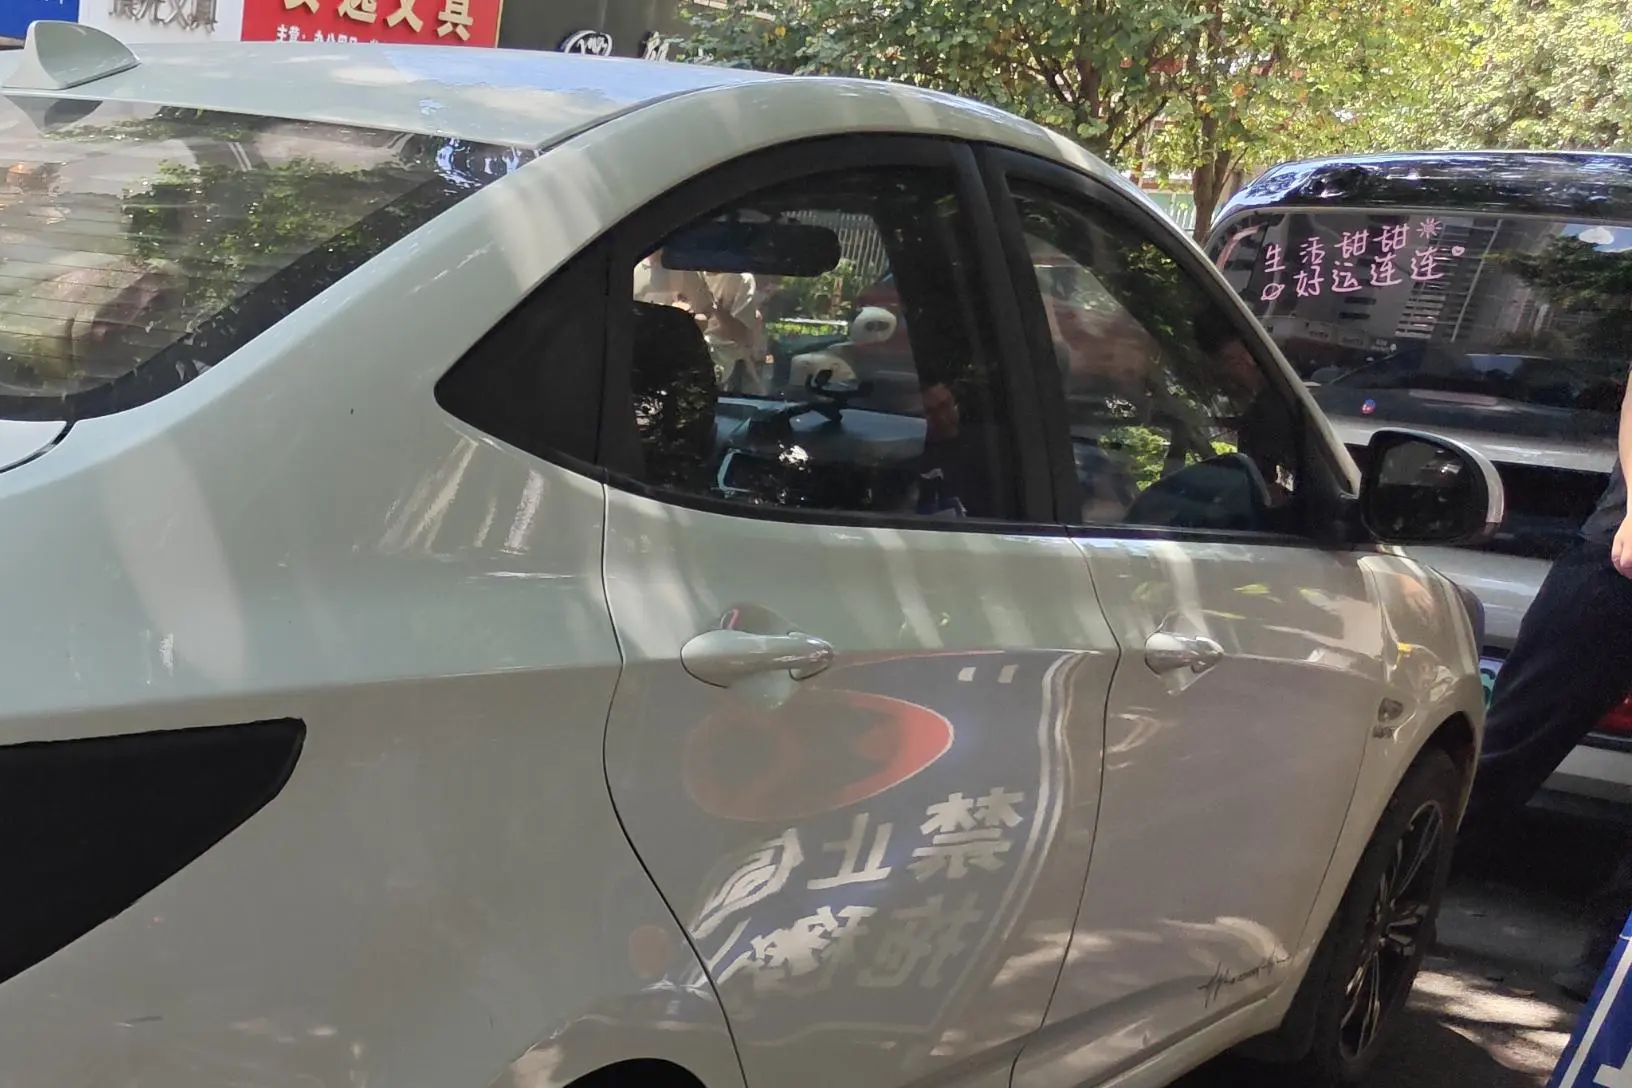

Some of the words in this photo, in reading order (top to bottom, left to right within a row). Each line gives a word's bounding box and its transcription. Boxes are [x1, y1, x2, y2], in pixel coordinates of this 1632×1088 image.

[282, 0, 474, 41] 文具
[1264, 223, 1410, 273] 生活甜甜
[1293, 246, 1446, 298] 好运连连
